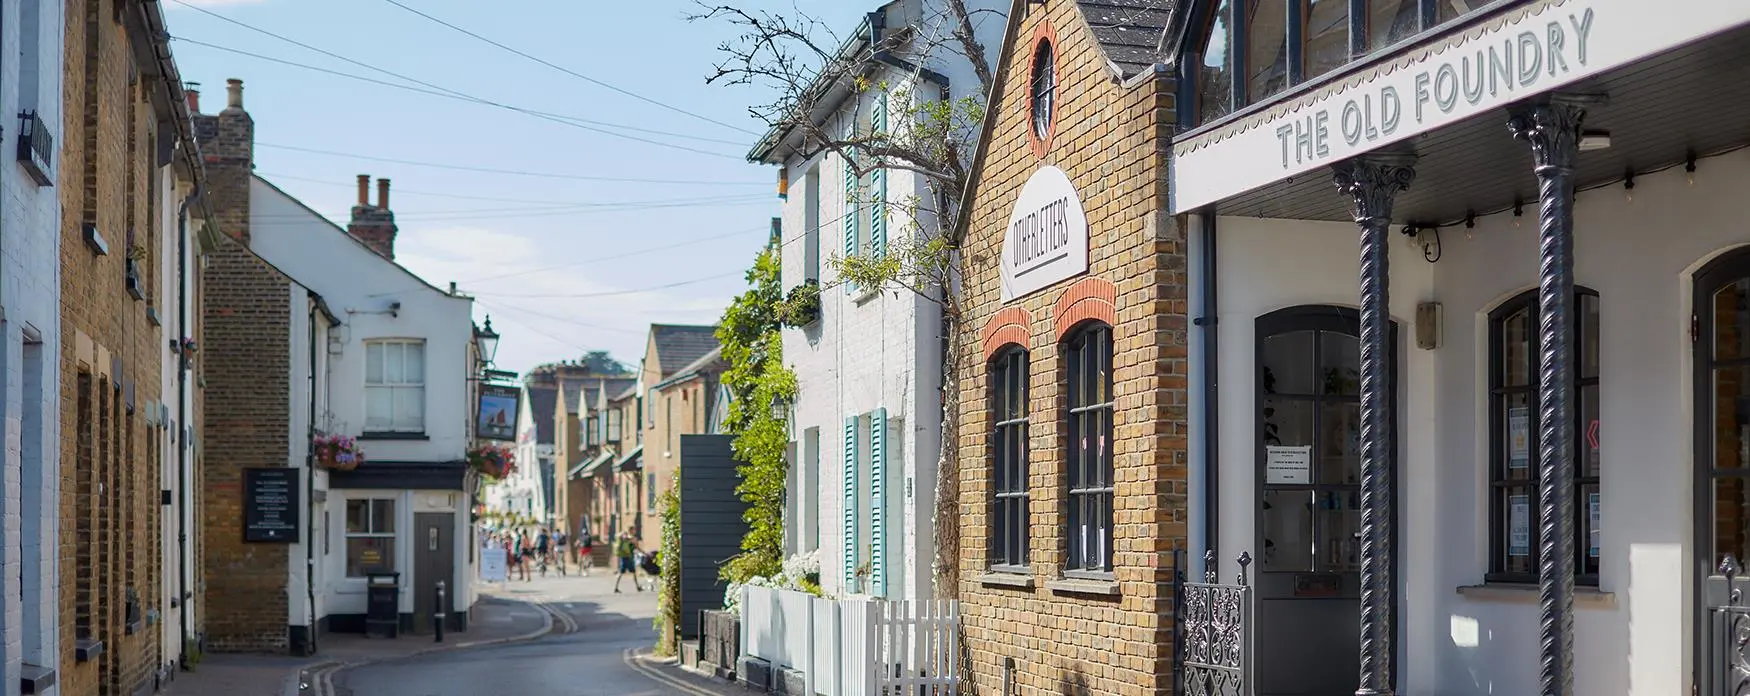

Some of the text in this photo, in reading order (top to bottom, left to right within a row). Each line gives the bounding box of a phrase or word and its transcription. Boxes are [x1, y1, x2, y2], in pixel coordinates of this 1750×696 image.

[1276, 7, 1595, 169] THE OLD FOUNDRY
[1013, 195, 1069, 268] OTHERLETTERS
